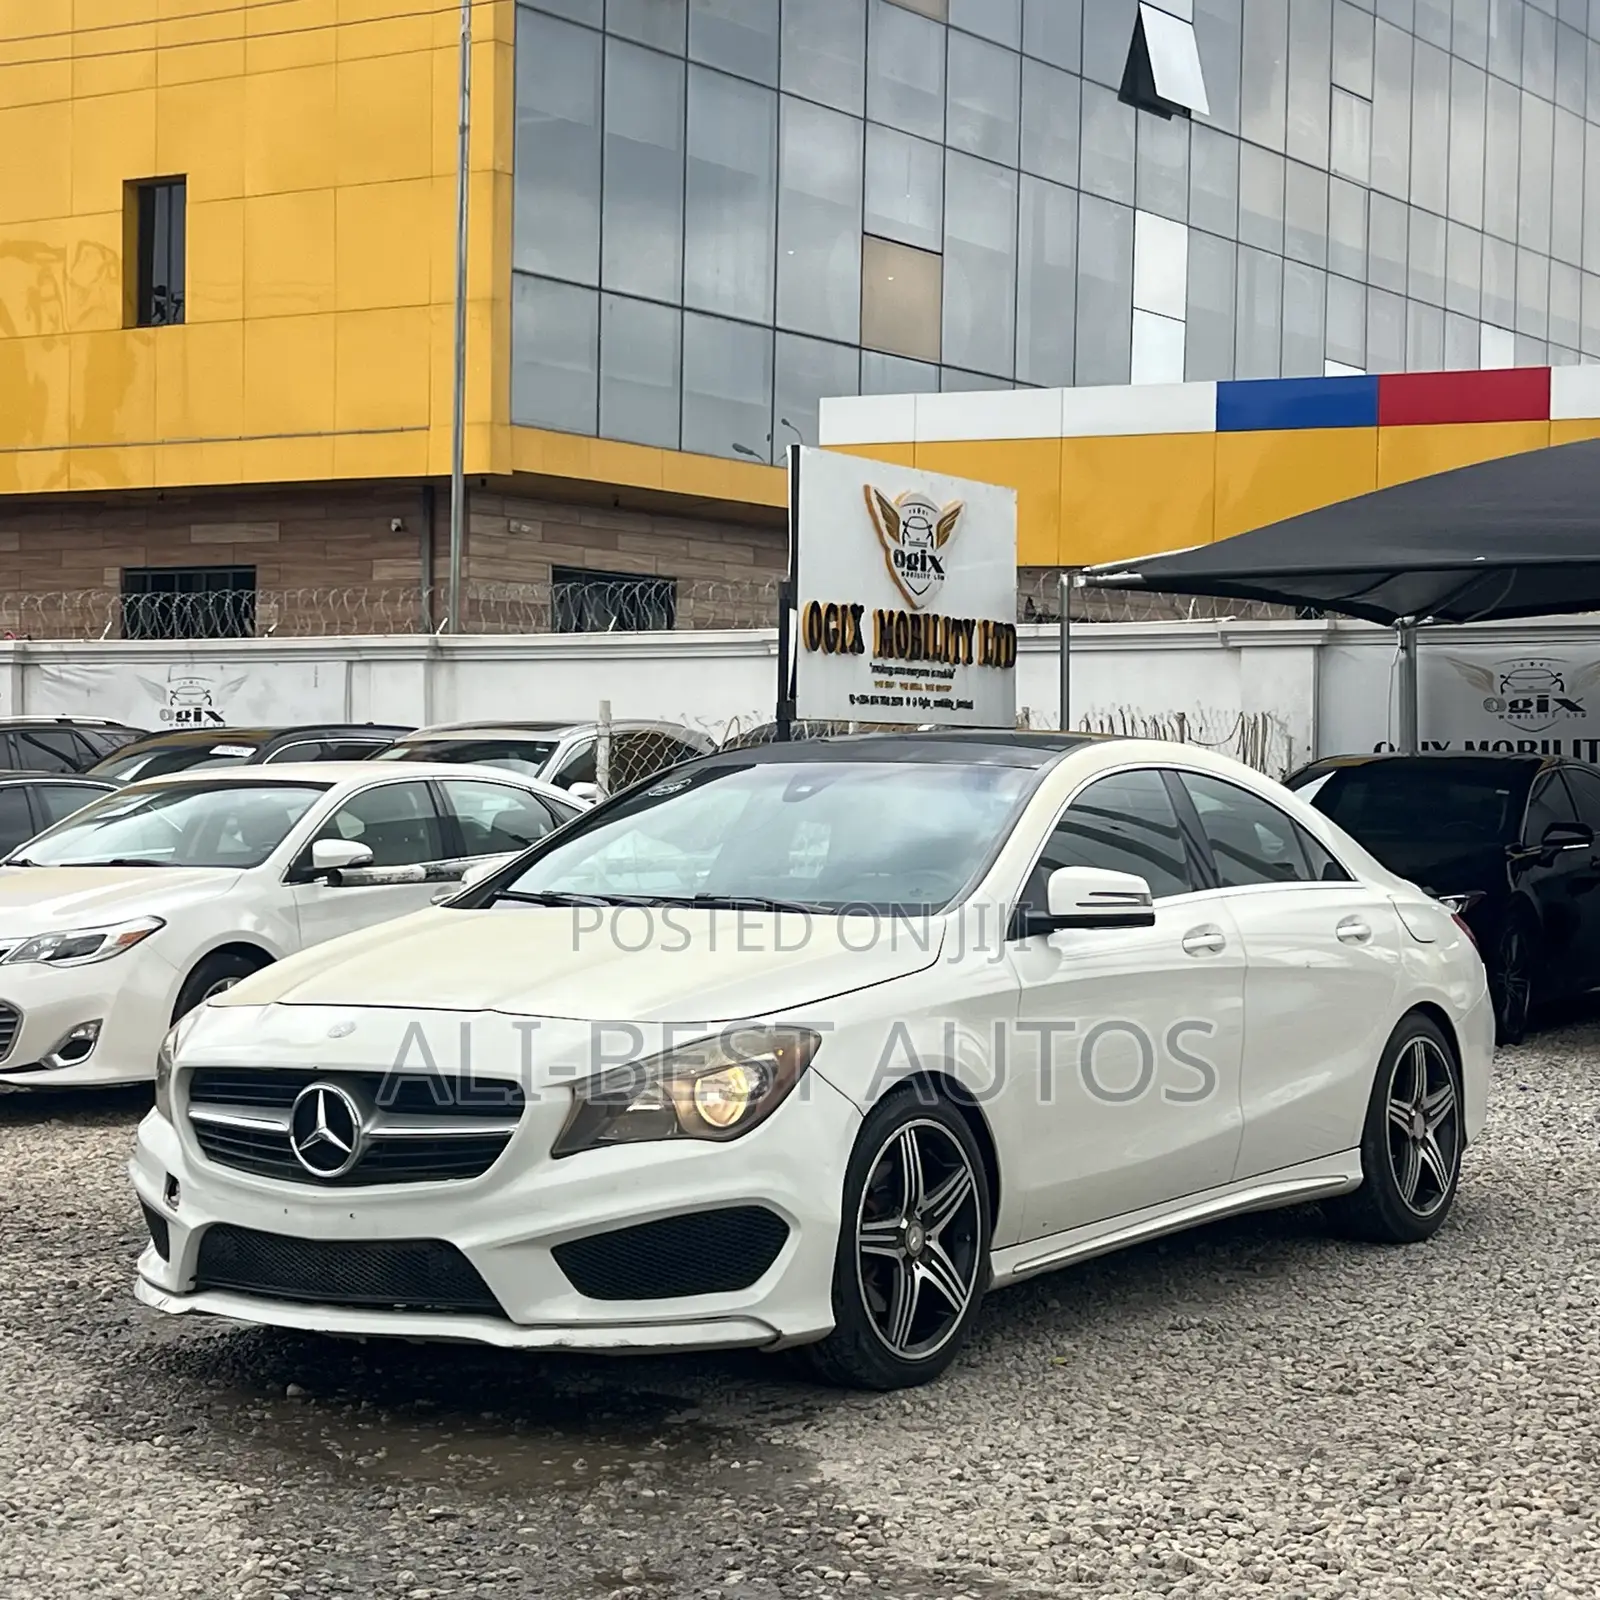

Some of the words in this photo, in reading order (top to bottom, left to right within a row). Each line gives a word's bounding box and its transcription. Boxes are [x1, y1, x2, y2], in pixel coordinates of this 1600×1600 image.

[802, 600, 865, 654] OGIX
[872, 608, 976, 666] MOBILITY
[977, 619, 1017, 668] LTD
